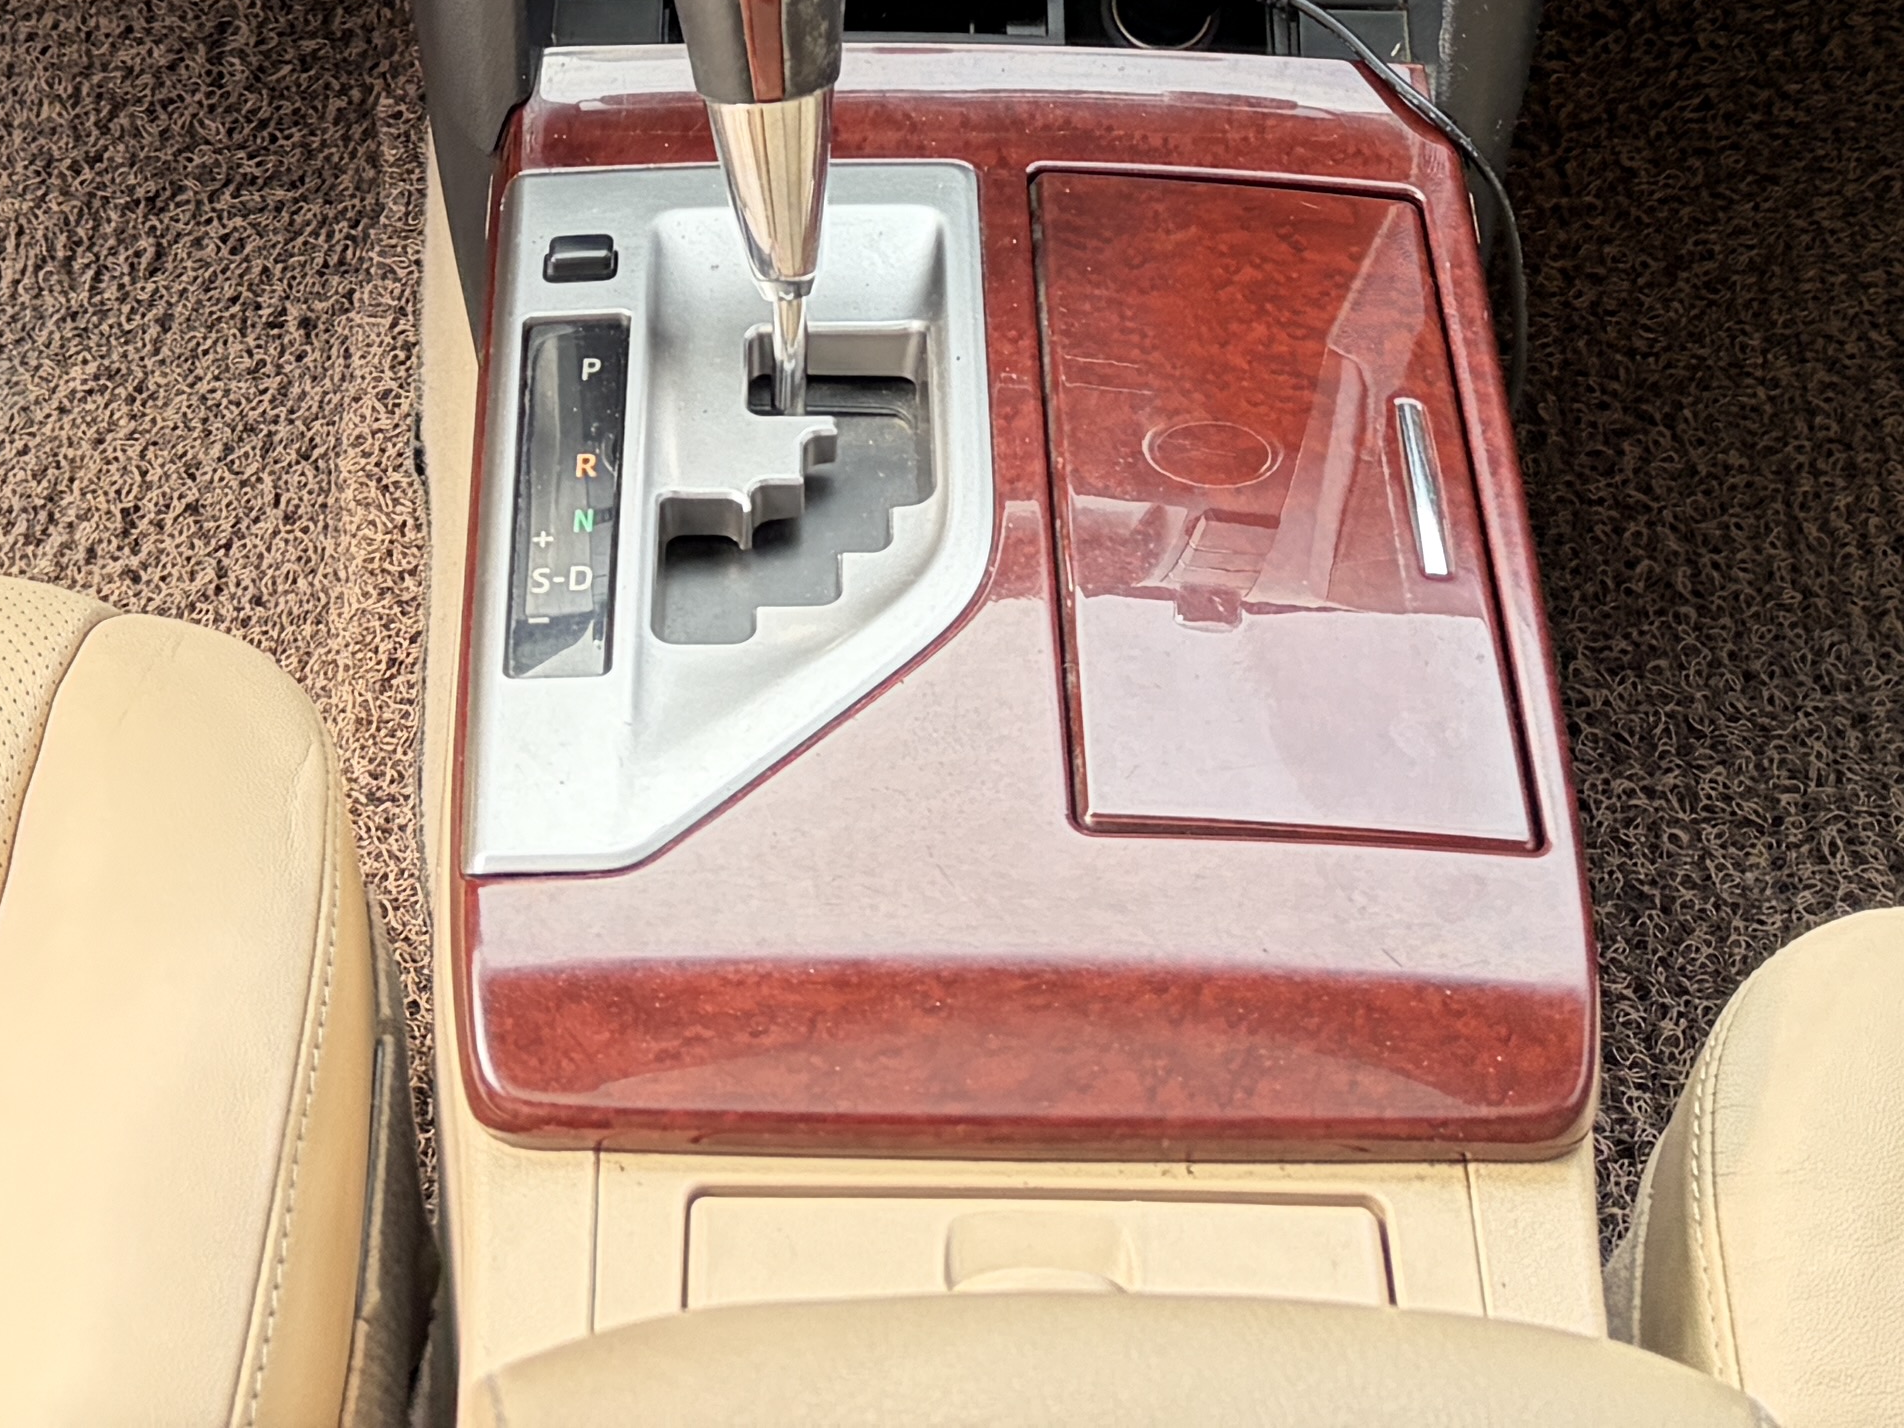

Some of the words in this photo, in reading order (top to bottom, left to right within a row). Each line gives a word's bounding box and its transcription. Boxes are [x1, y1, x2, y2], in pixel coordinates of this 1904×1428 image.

[581, 357, 602, 381] P
[575, 454, 597, 478] R
[573, 509, 594, 532] N
